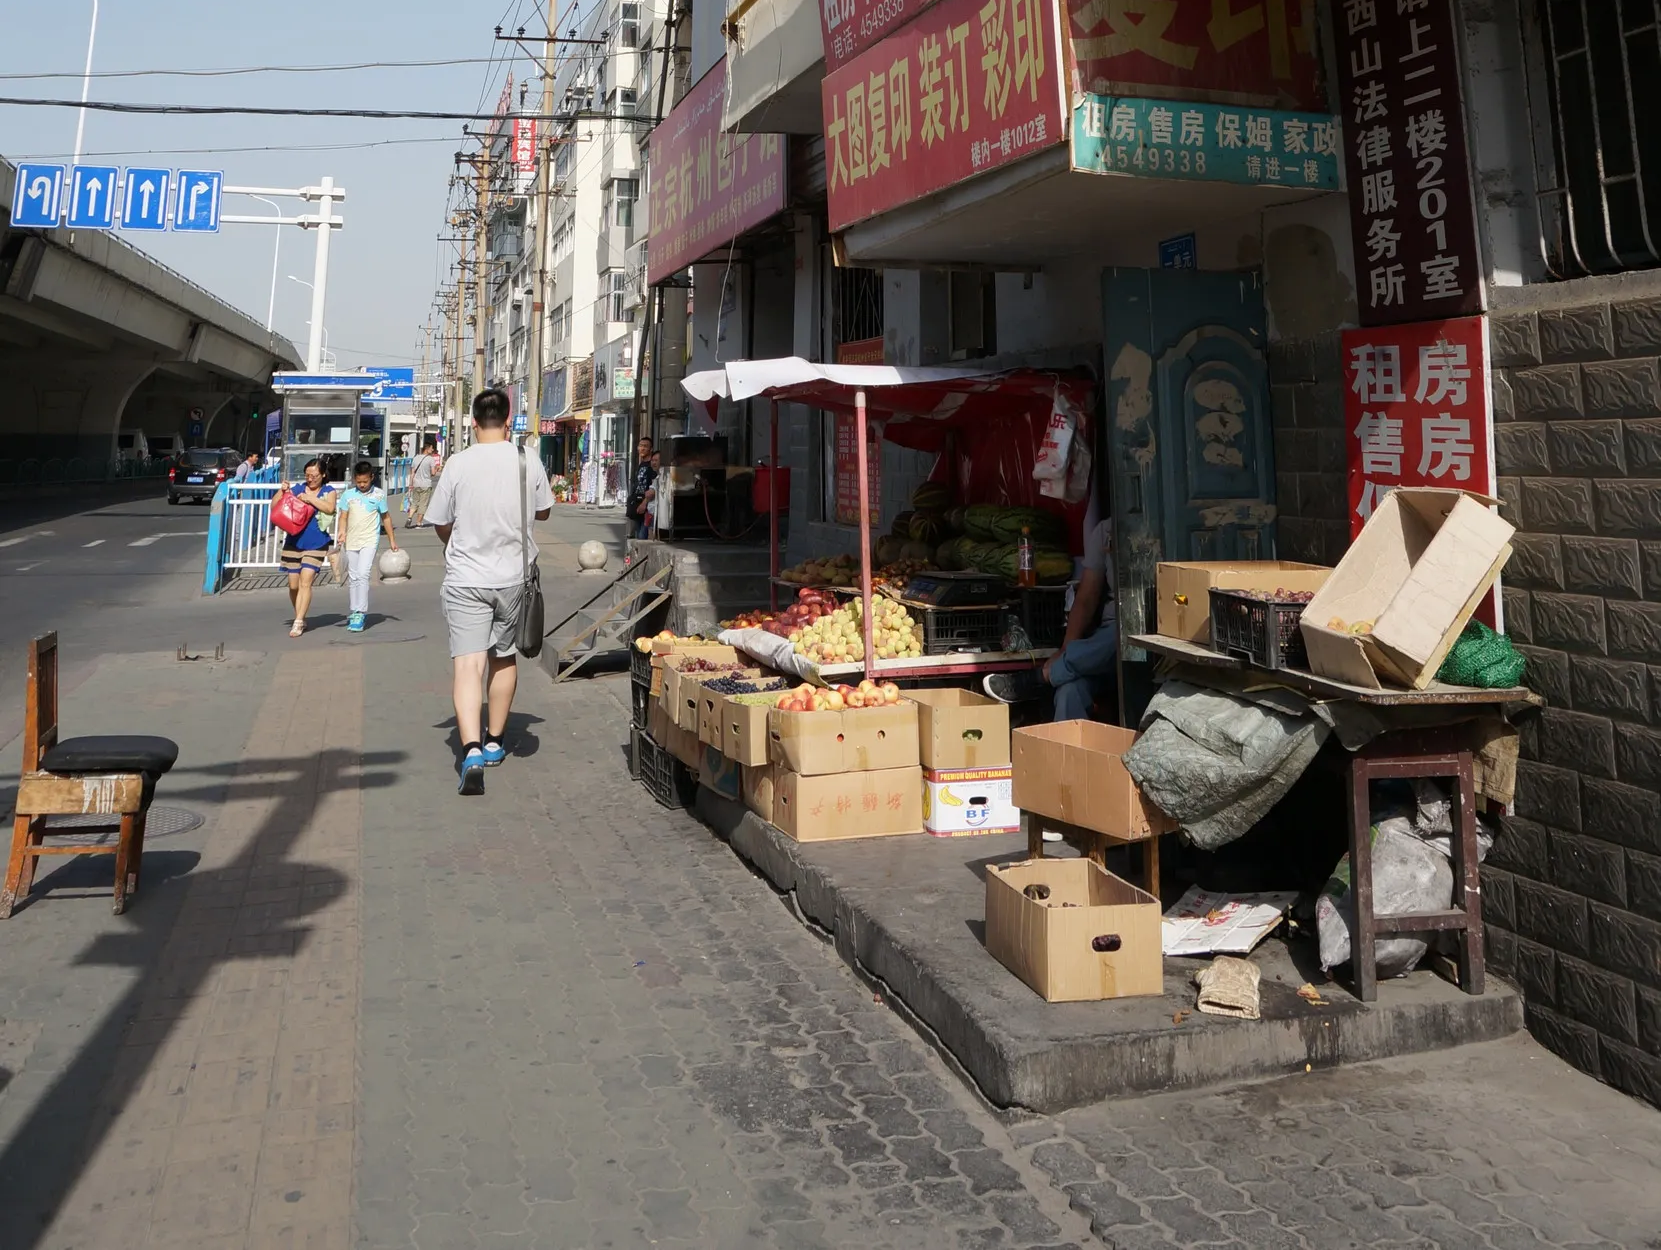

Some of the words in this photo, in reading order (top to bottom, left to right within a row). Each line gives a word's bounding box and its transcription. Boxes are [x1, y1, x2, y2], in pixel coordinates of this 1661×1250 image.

[827, 57, 912, 194] 大图复印
[918, 22, 971, 149] 装订
[1081, 100, 1137, 142] 租房
[1147, 106, 1206, 147] 售房
[1214, 111, 1274, 152] 保姆
[1282, 117, 1337, 158] 家政
[971, 113, 1047, 168] 楼内一楼1012室
[1101, 146, 1207, 175] 4549338
[1246, 154, 1320, 184] 请进一楼
[1350, 340, 1472, 406] 租房
[1353, 411, 1475, 481] 售房
[965, 771, 987, 779] QUALITY
